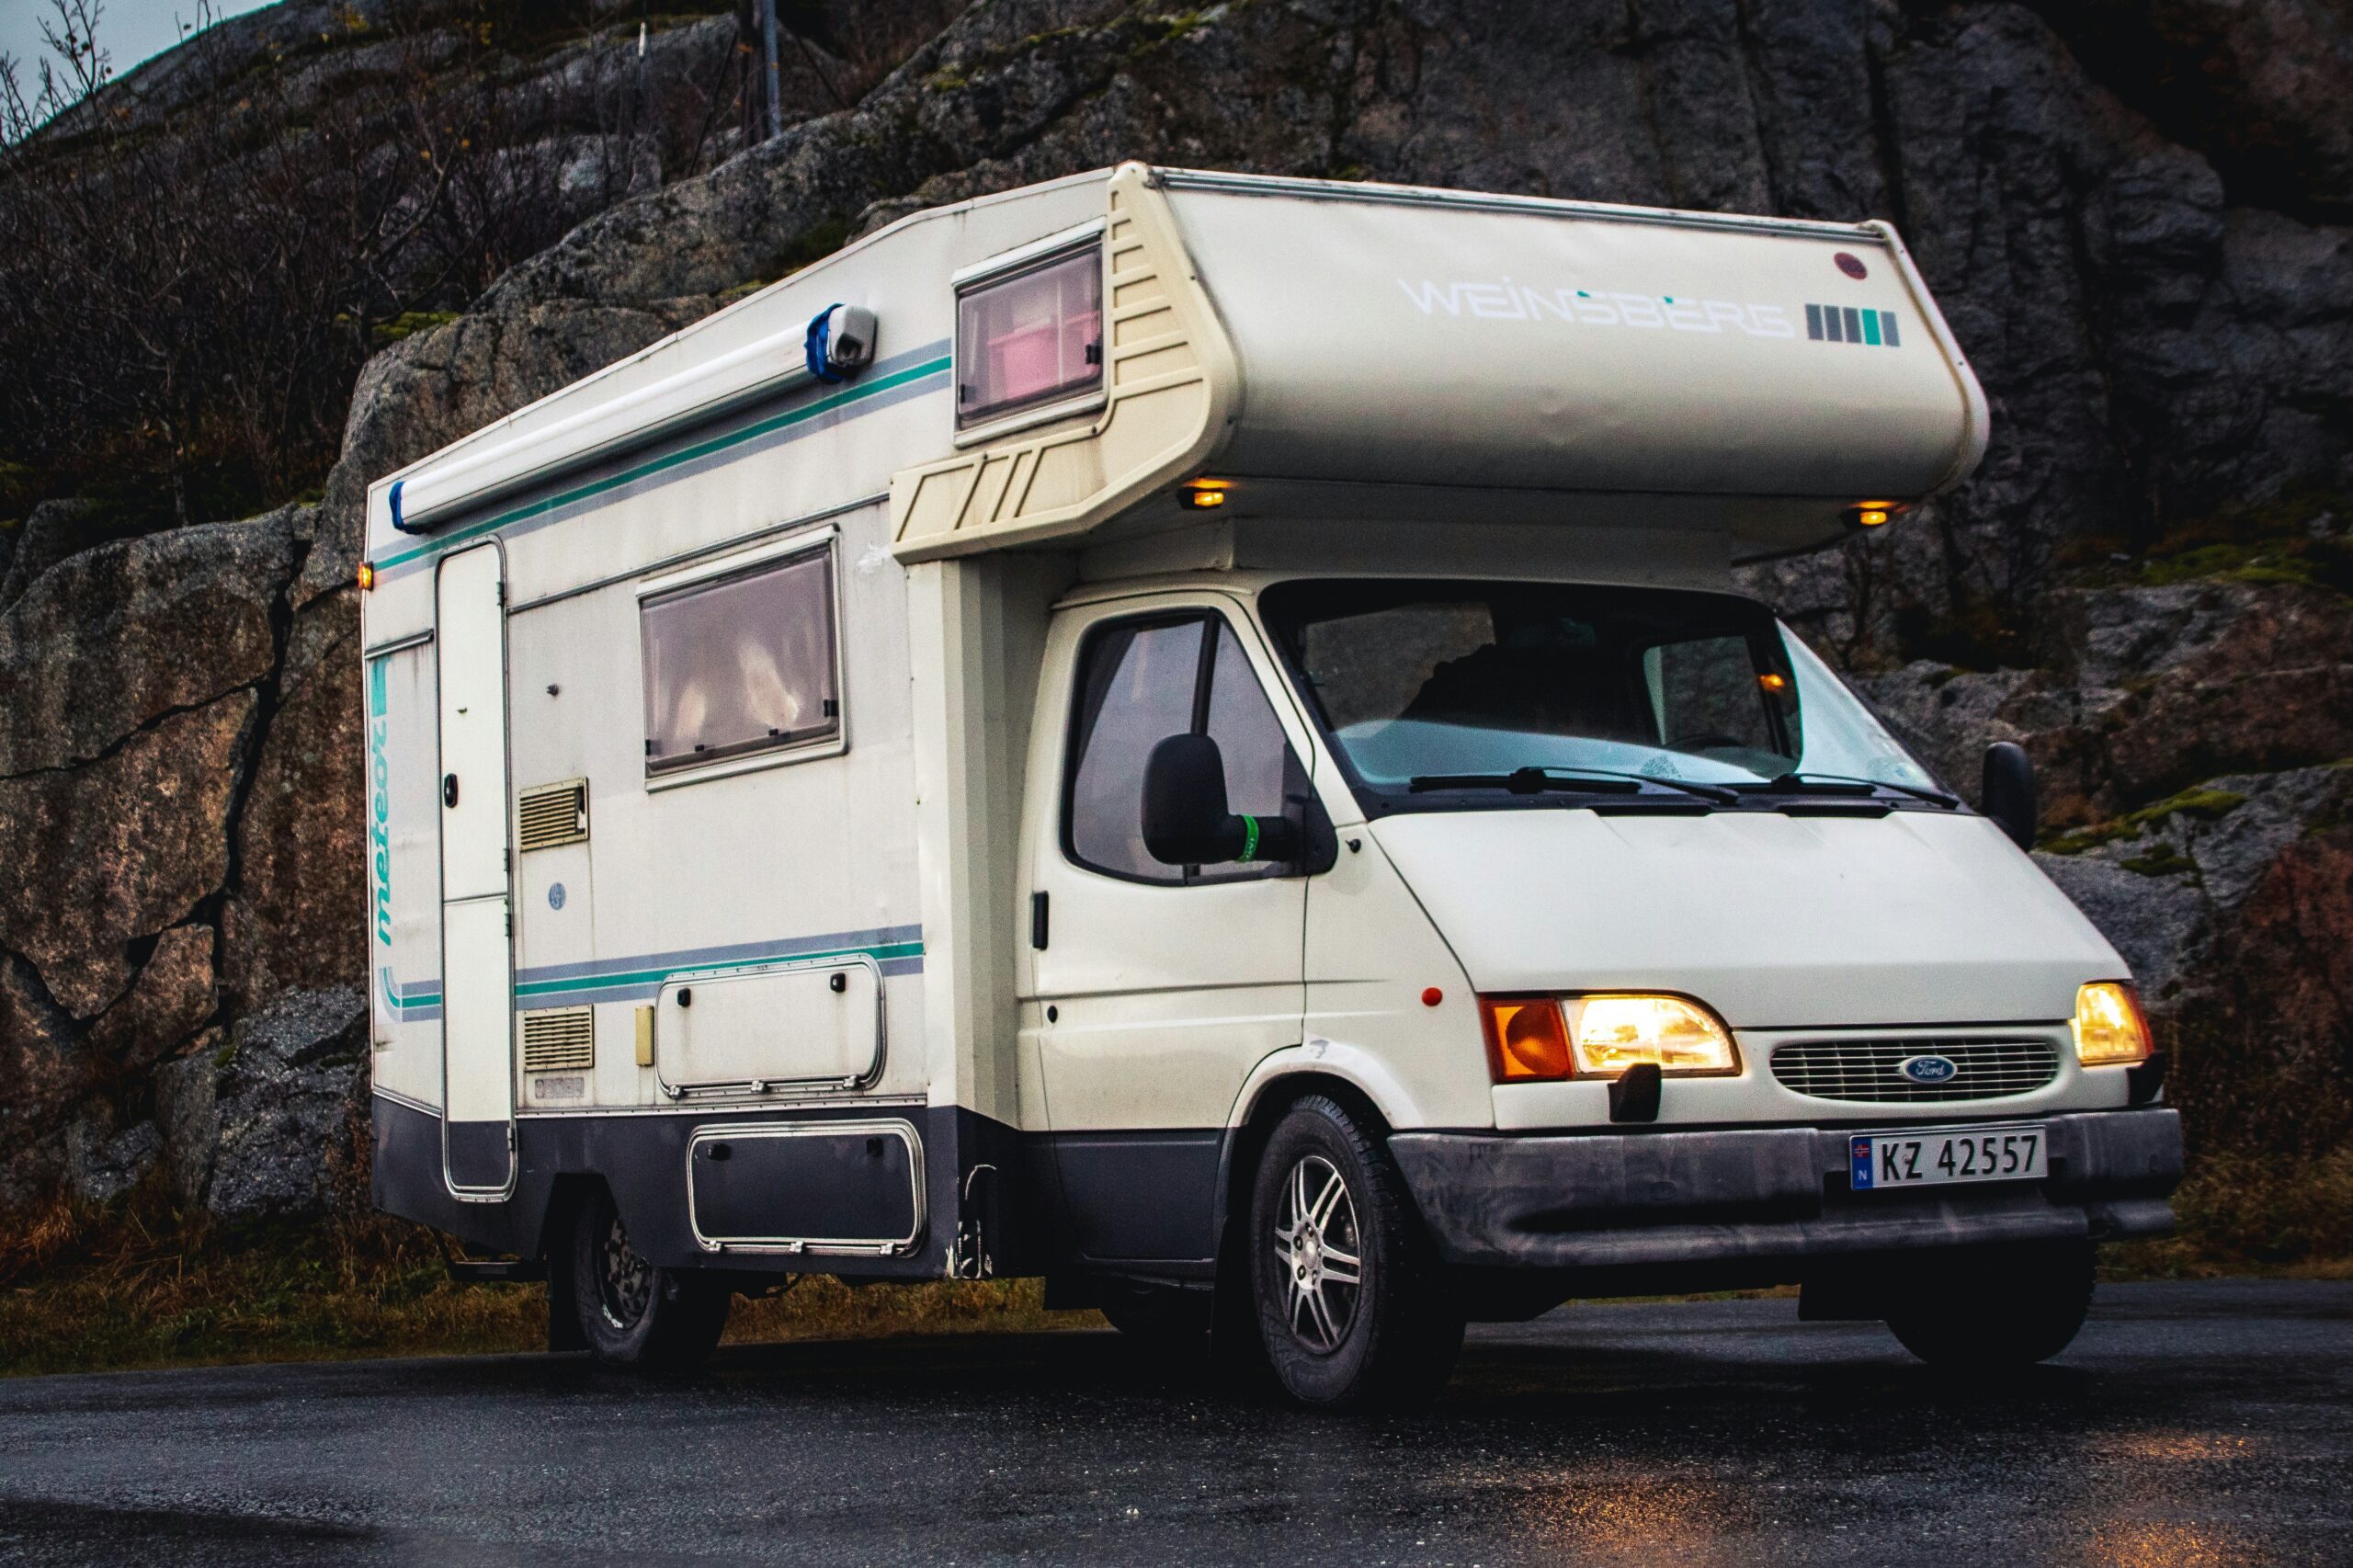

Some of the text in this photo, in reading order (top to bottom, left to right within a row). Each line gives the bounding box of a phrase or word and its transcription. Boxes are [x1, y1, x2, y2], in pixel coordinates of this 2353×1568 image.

[371, 720, 392, 947] meteor
[1915, 1060, 1946, 1076] Ford
[1881, 1134, 2038, 1181] KZ 42557
[1858, 1169, 1867, 1181] N
